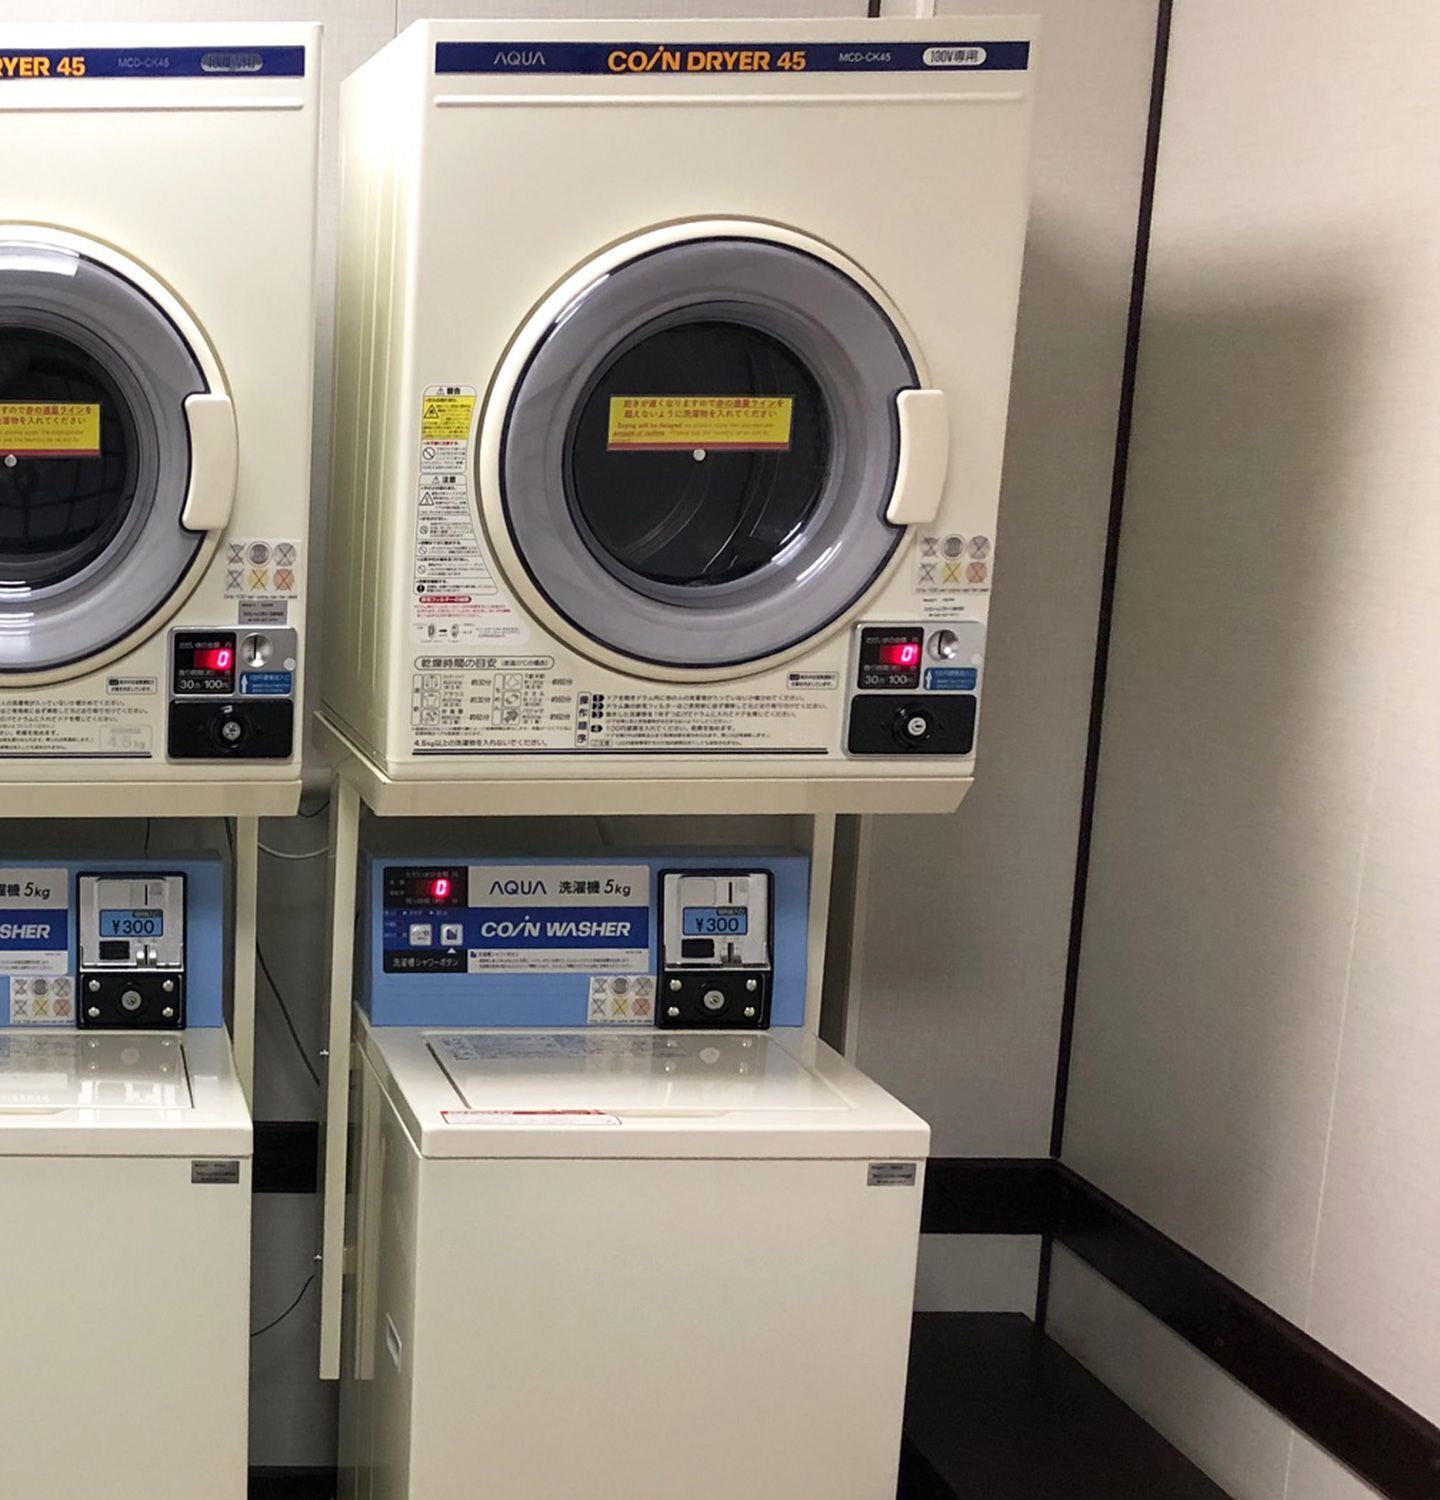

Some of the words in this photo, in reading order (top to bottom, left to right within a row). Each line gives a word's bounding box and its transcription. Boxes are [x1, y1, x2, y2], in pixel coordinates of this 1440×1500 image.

[494, 52, 545, 65] AQUA
[687, 52, 769, 71] DRYER
[777, 51, 807, 70] 45
[839, 52, 891, 62] MCD-CK45
[56, 57, 86, 76] 45
[217, 651, 229, 667] 0
[901, 646, 913, 662] 0
[421, 659, 497, 668] 乾燥時間の目安
[24, 882, 50, 899] 5kg
[435, 880, 447, 896] 0
[489, 880, 547, 895] AQUA
[559, 880, 601, 895] 洗濯機
[604, 879, 631, 897] 5kg
[112, 920, 155, 934] ¥300
[546, 922, 631, 937] WASHER
[695, 918, 739, 932] ¥300
